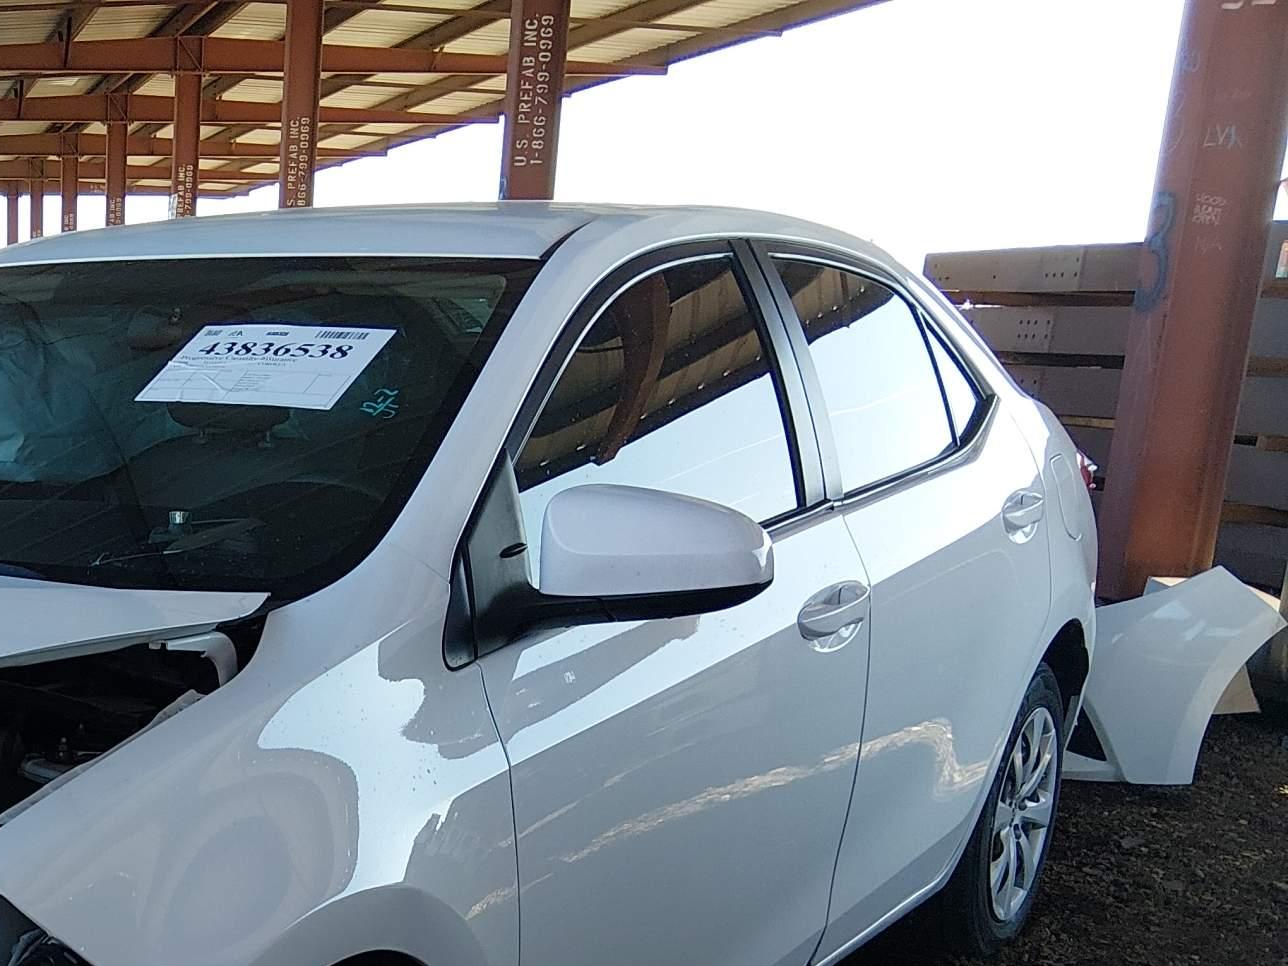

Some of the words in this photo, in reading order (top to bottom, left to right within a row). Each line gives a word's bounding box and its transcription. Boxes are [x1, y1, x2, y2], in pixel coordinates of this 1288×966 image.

[523, 13, 540, 47] INC.
[517, 55, 536, 124] PREFAB
[289, 116, 301, 139] INC.
[287, 144, 298, 190] PREFAB
[198, 341, 354, 360] 43836538
